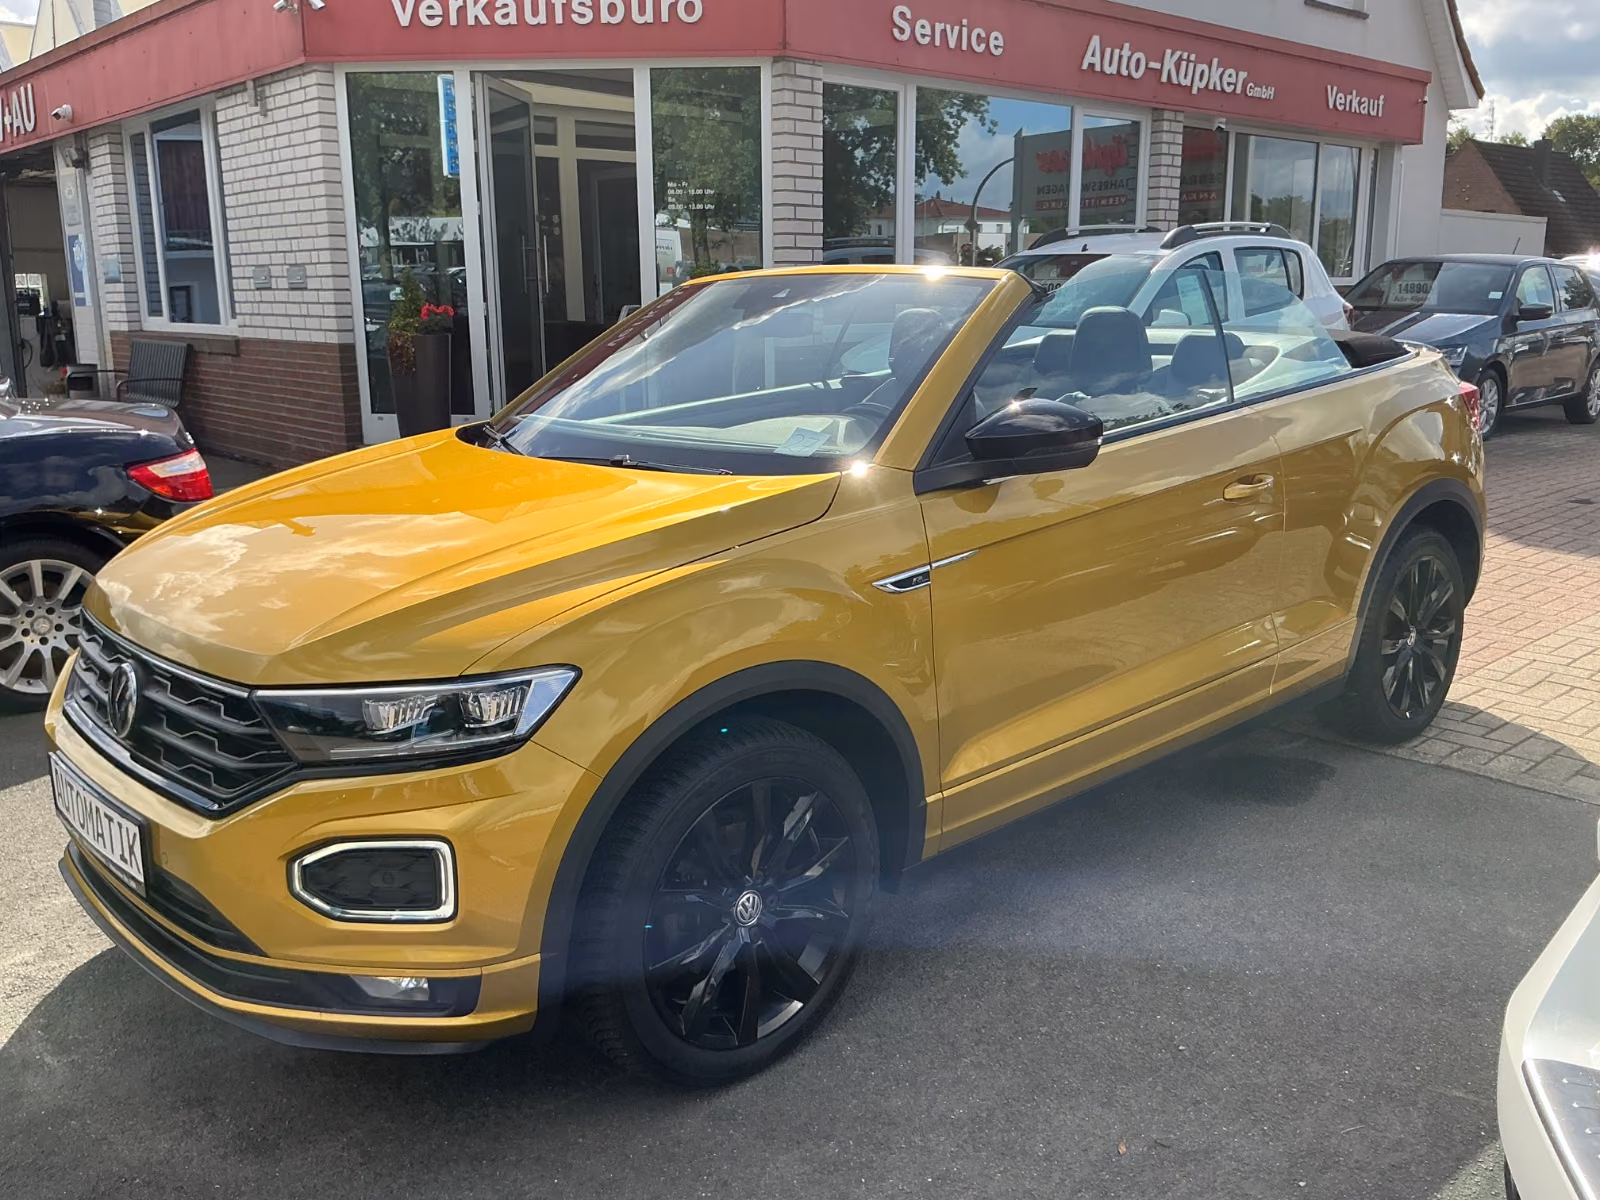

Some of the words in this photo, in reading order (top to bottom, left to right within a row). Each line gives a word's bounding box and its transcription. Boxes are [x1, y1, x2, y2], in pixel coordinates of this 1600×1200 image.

[892, 5, 1004, 56] Service
[1081, 34, 1247, 95] Auto-Küpker
[1246, 82, 1275, 100] GmbH
[0, 83, 35, 142] +AU
[1327, 84, 1385, 117] Verkauf
[54, 766, 142, 876] AUTOMATIK
